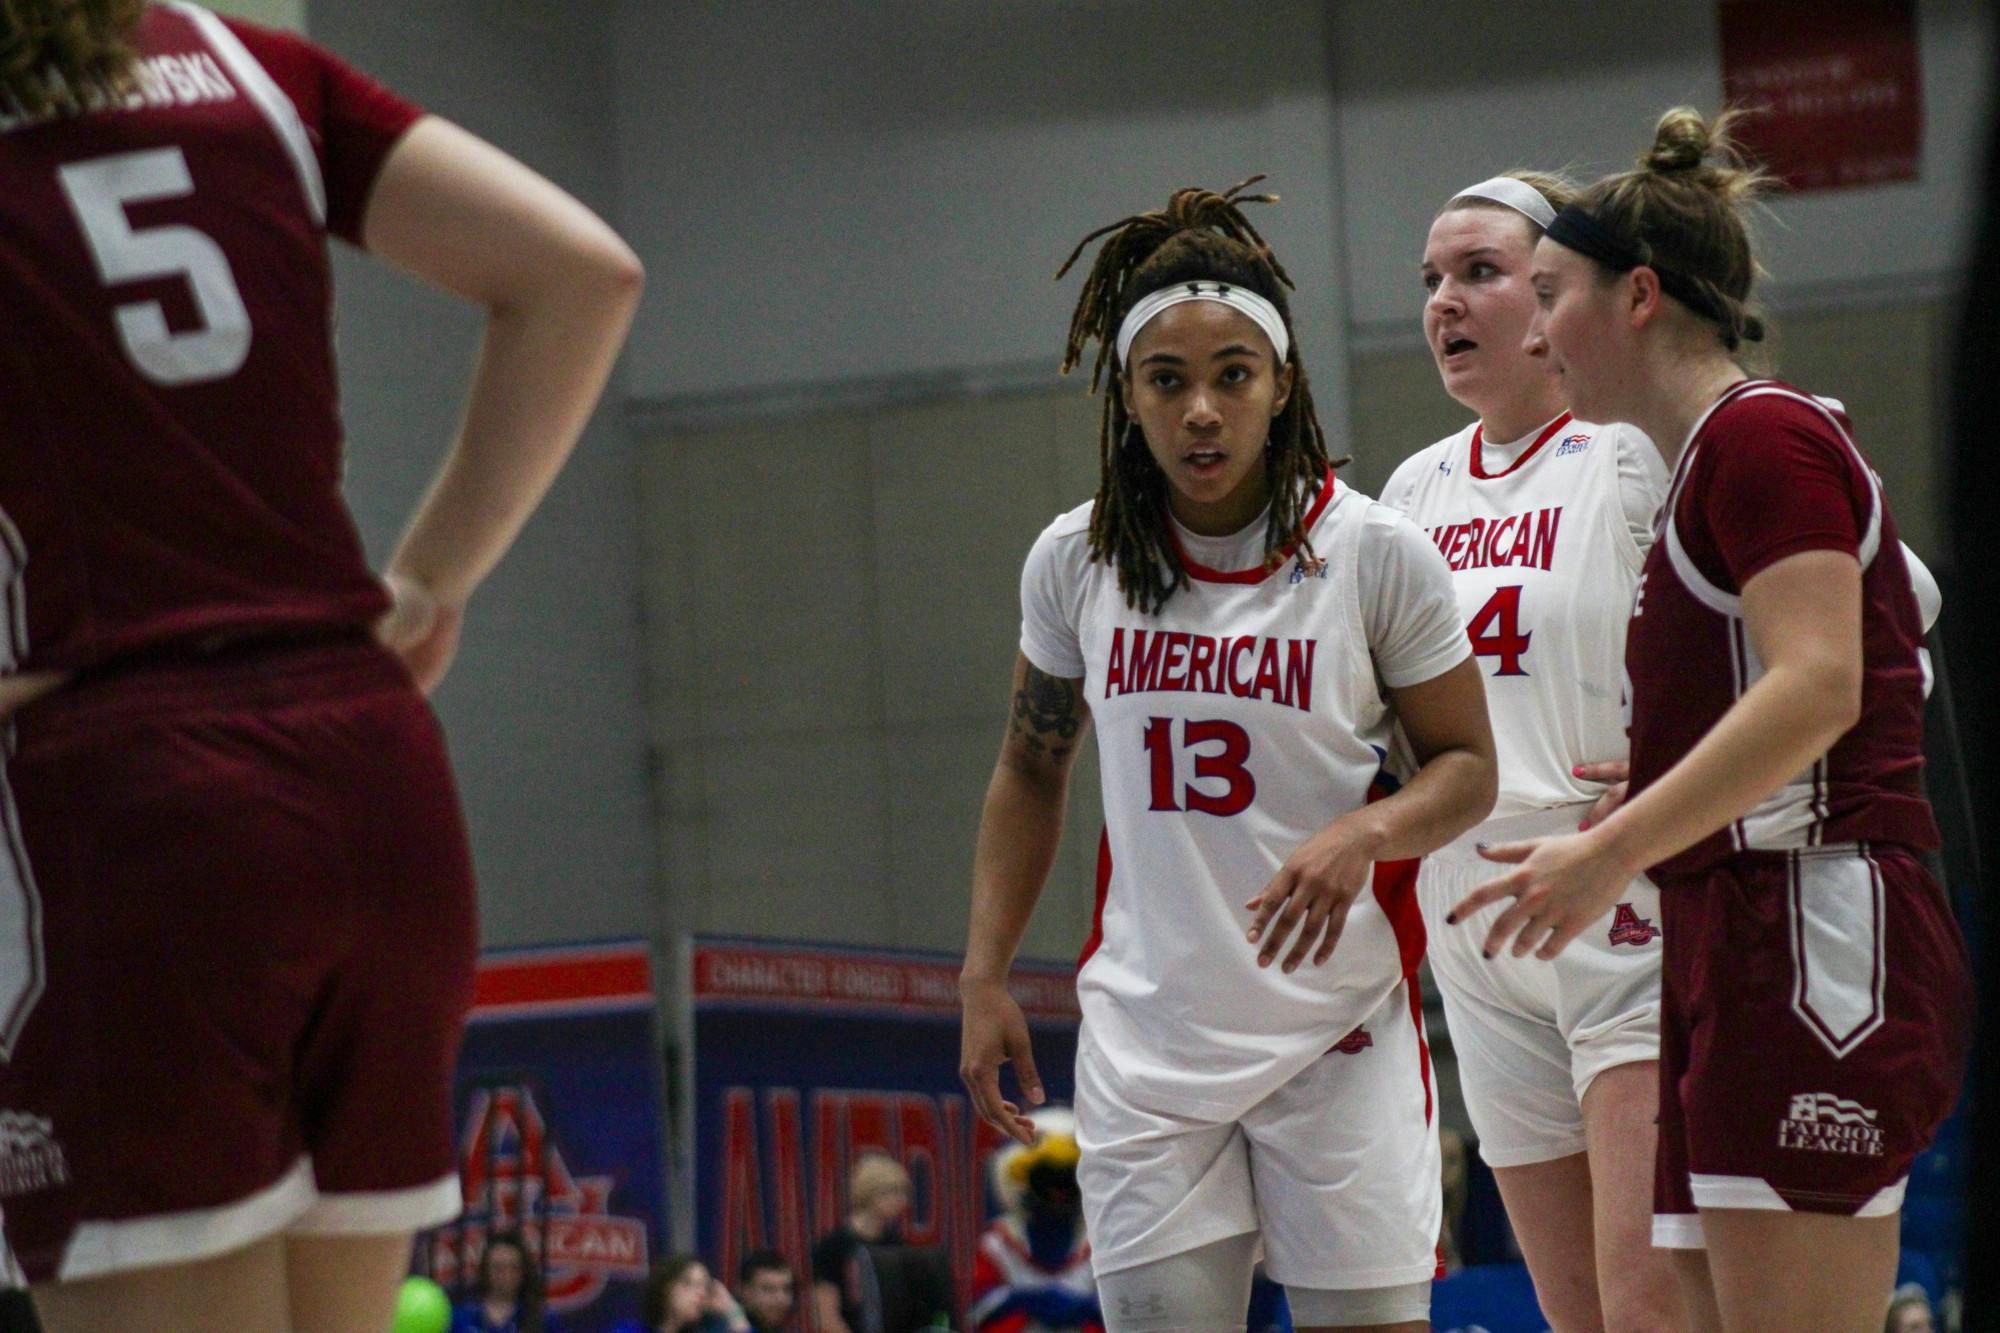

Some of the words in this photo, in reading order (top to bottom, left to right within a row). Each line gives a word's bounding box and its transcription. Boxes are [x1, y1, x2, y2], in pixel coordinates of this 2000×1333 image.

[57, 145, 253, 387] 5
[1424, 506, 1563, 572] MERICAN
[1105, 627, 1318, 713] AMERICAN
[1144, 716, 1257, 818] 13
[1778, 1133, 1884, 1156] LEAGUE
[1779, 1119, 1885, 1142] PATRIOT
